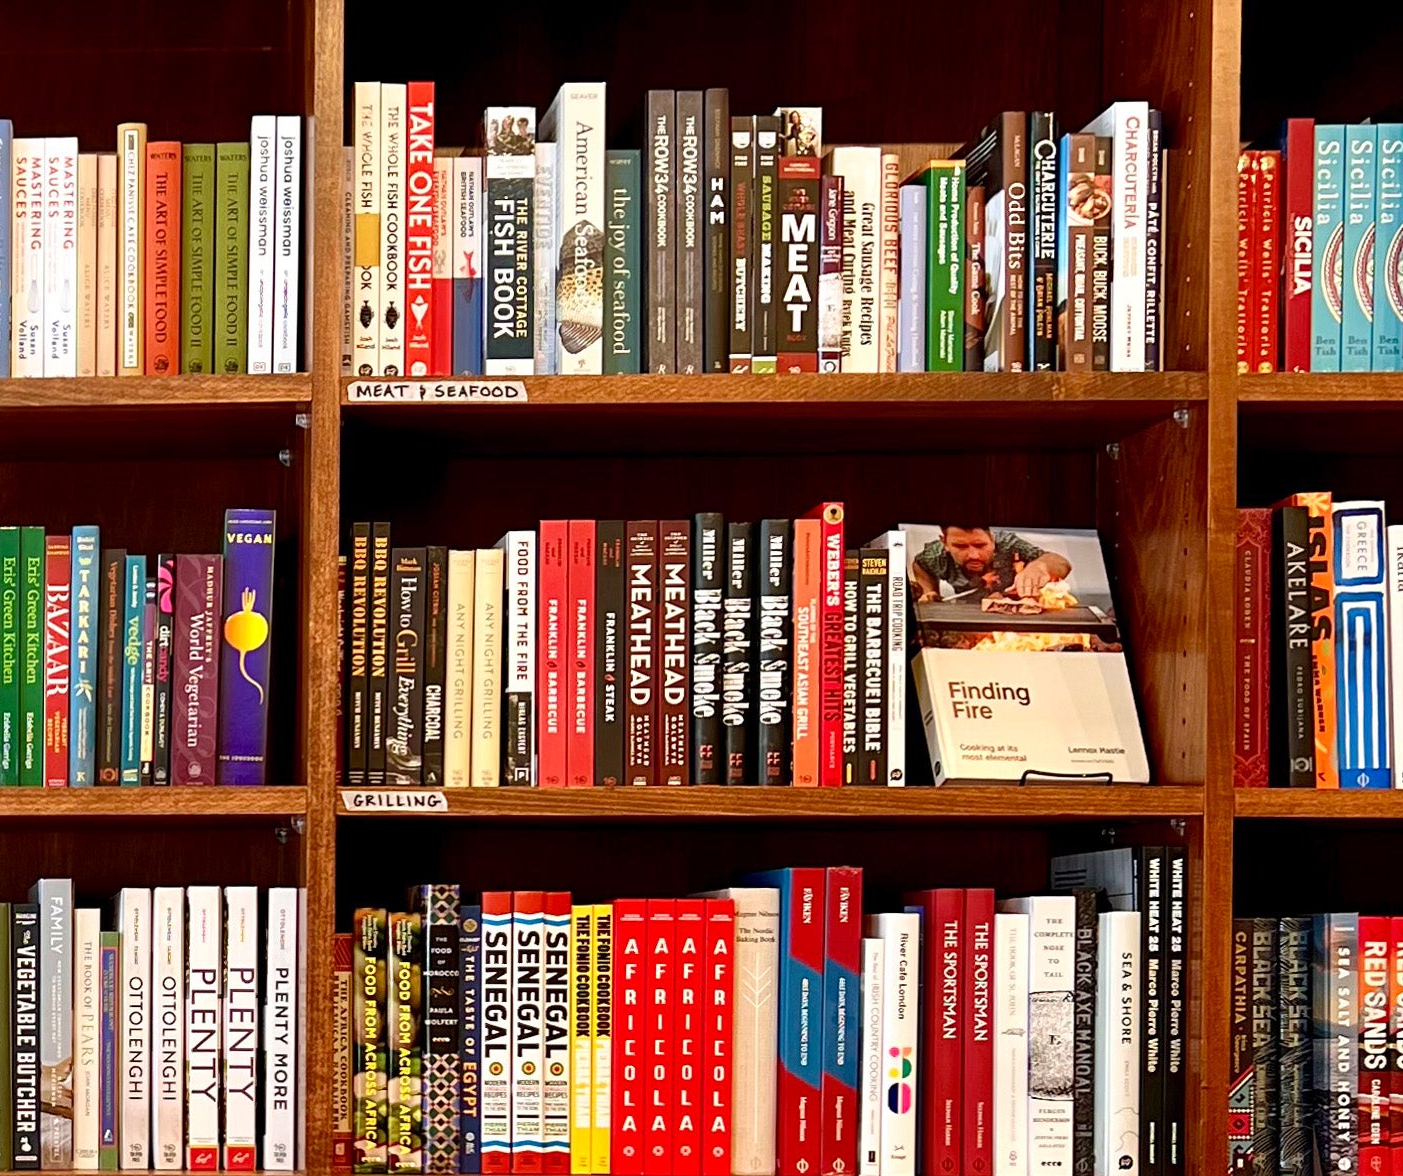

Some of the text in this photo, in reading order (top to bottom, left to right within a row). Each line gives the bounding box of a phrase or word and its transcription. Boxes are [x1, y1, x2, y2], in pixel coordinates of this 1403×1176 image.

[16, 157, 26, 218] SAUCES
[30, 157, 41, 250] MASTERING
[257, 135, 271, 256] joshua weissman
[409, 103, 433, 290] TAKE ONE FISH
[710, 177, 724, 225] HAM
[1317, 140, 1339, 224] Sicilia
[155, 173, 166, 343] THE ART OF SIMPLE FOOD
[781, 214, 815, 332] MEAT
[1294, 216, 1312, 295] SICILIA
[356, 385, 409, 398] MEAT
[434, 385, 519, 398] SEAFOOD
[227, 532, 273, 544] VEGAN
[1356, 522, 1367, 572] GREECE
[46, 584, 69, 697] BAZAAR
[78, 570, 90, 674] TARKARI
[606, 613, 615, 673] FRANKLIN
[630, 564, 652, 706] MEATHEAD
[948, 683, 1030, 705] Finding
[953, 702, 993, 719] Fire
[353, 796, 441, 807] GRILLING
[191, 968, 216, 1102] PLENTY
[485, 931, 507, 1058] SENEGAL
[622, 939, 639, 1131] AFRICOLA
[943, 920, 958, 1039] THE SPORTSMAN
[1364, 941, 1387, 1070] RED SANDS
[16, 945, 37, 1132] VEGETABLE BUTCHER
[129, 977, 143, 1100] OTTOLENGHI
[1338, 948, 1350, 1141] SEA SALT AND HONEY
